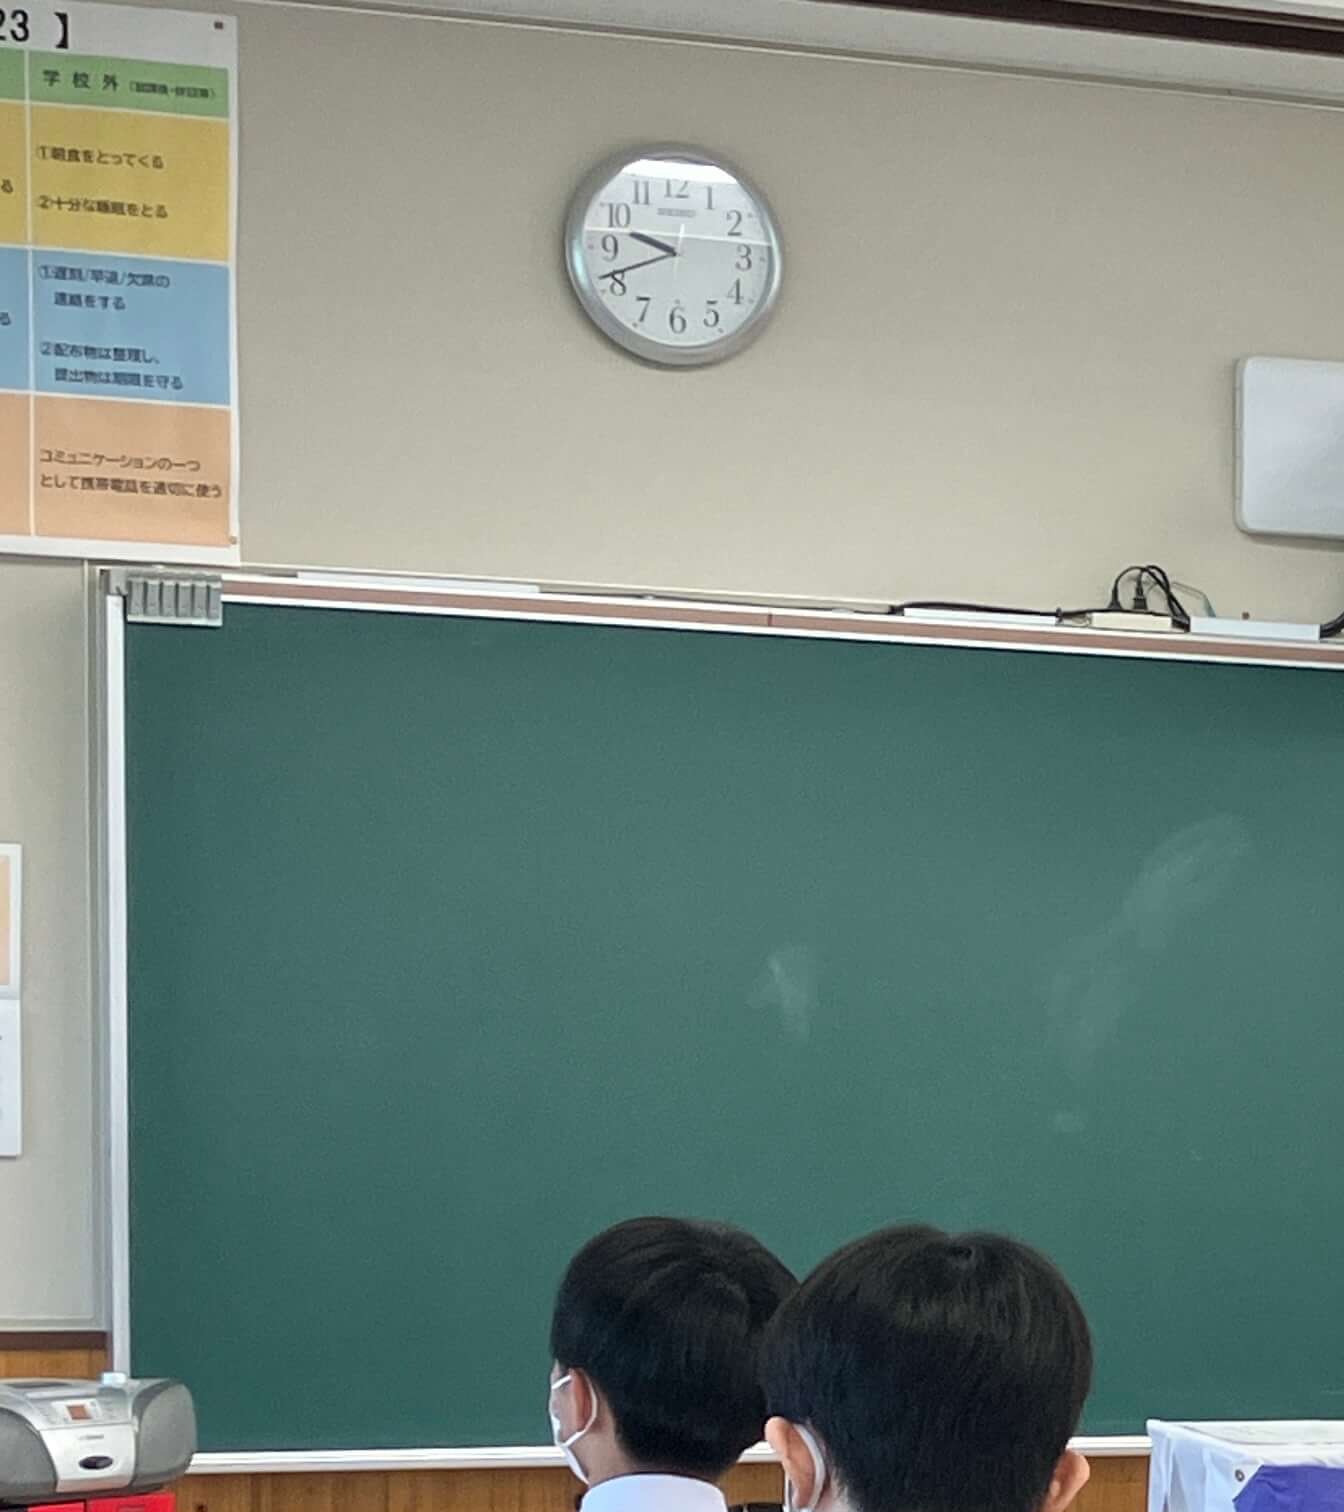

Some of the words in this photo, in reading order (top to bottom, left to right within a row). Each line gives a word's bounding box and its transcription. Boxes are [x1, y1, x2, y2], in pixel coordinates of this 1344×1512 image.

[632, 179, 651, 206] 11
[705, 185, 716, 210] 1
[606, 202, 632, 229] 10
[726, 209, 743, 237] 2
[601, 234, 619, 262] 9
[735, 244, 753, 272] 3
[609, 270, 628, 297] 8
[727, 277, 744, 305] 4
[635, 296, 652, 323] 7
[668, 305, 687, 334] 6
[703, 299, 720, 328] 5
